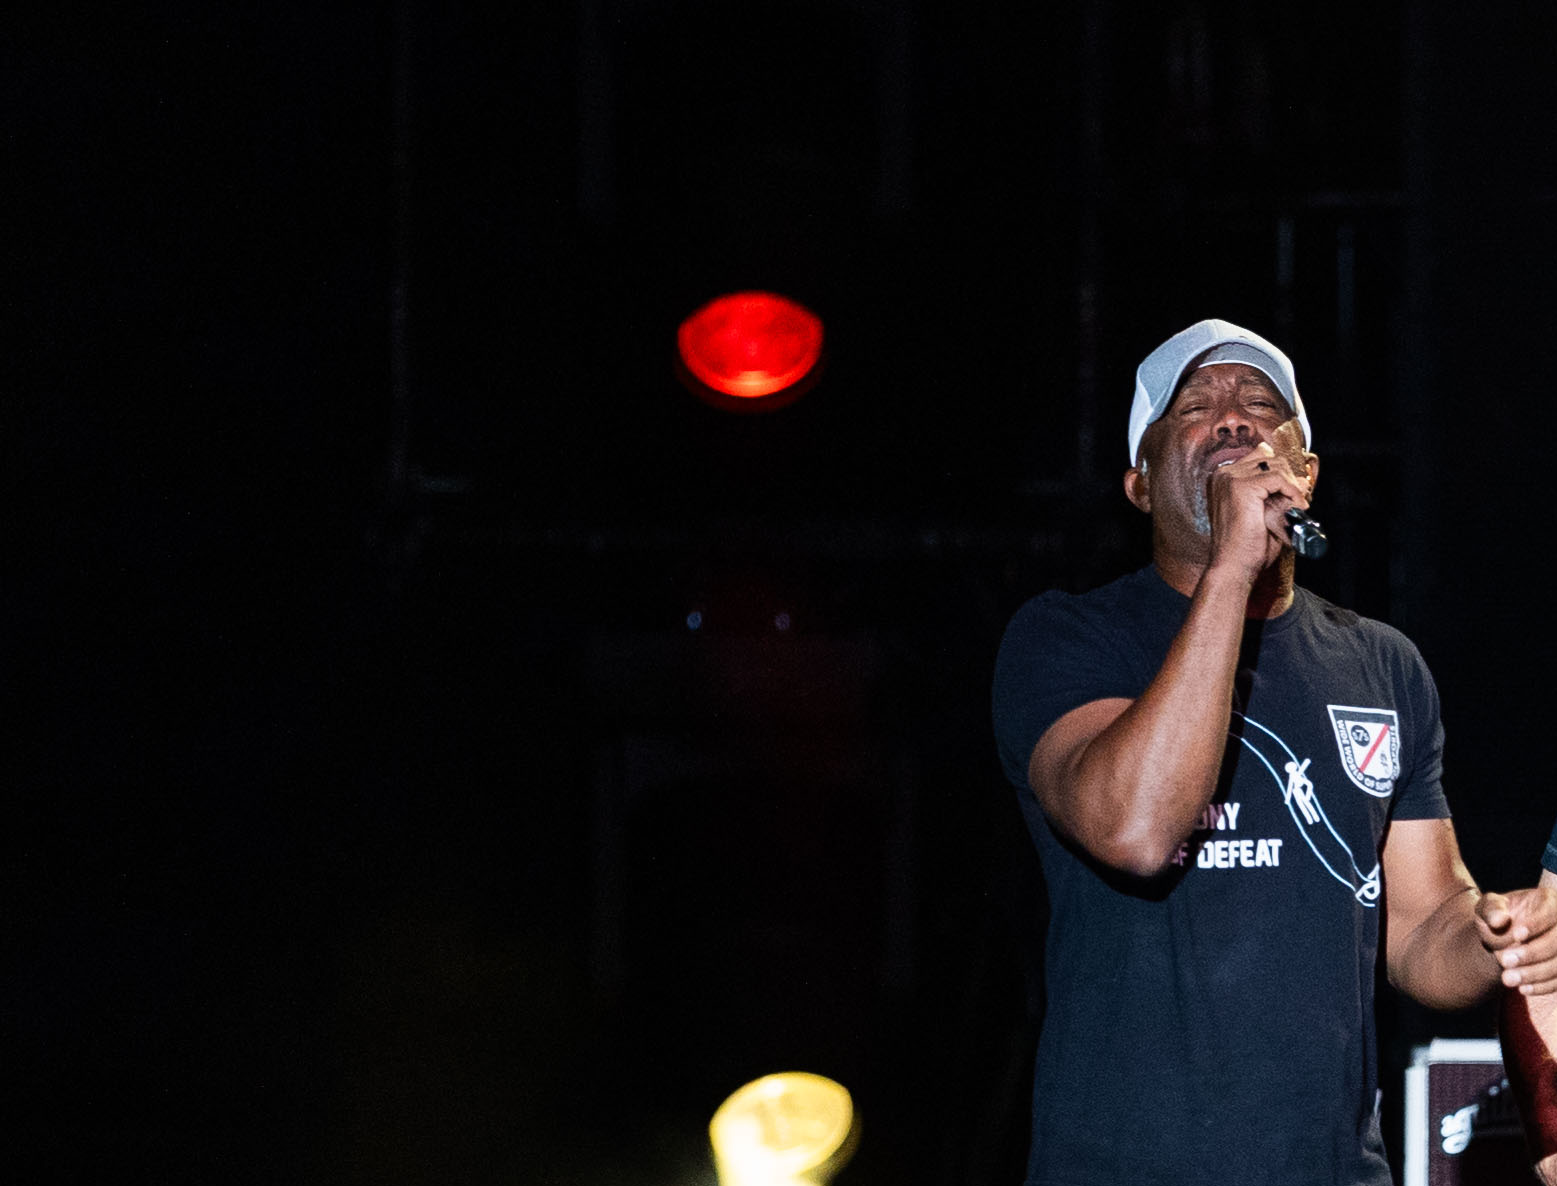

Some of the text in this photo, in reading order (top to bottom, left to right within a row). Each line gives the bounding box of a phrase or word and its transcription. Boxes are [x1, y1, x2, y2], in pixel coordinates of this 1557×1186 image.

[1337, 719, 1349, 745] WIDE
[1344, 746, 1364, 781] WORLD
[1198, 839, 1283, 869] DEFEAT
